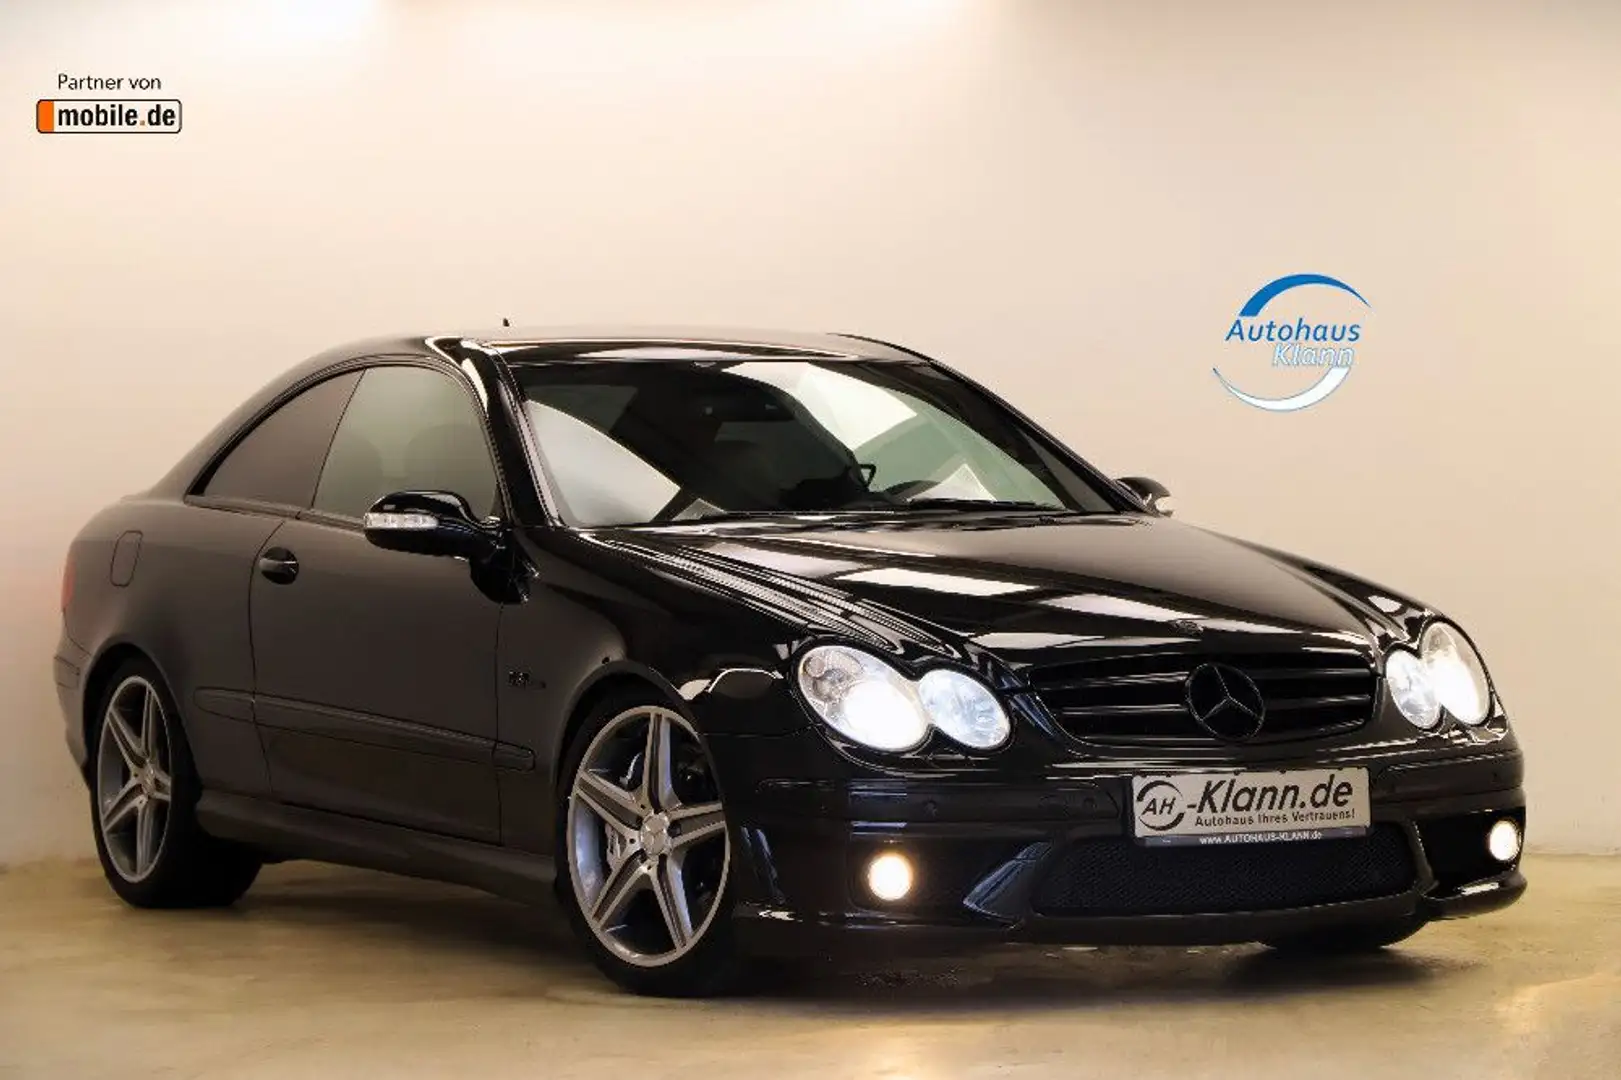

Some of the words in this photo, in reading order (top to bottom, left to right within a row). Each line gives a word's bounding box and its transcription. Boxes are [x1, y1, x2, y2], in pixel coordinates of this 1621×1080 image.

[1194, 815, 1254, 827] Autohaus
[1258, 814, 1288, 824] Ihres
[1292, 808, 1356, 823] Vertrauens!
